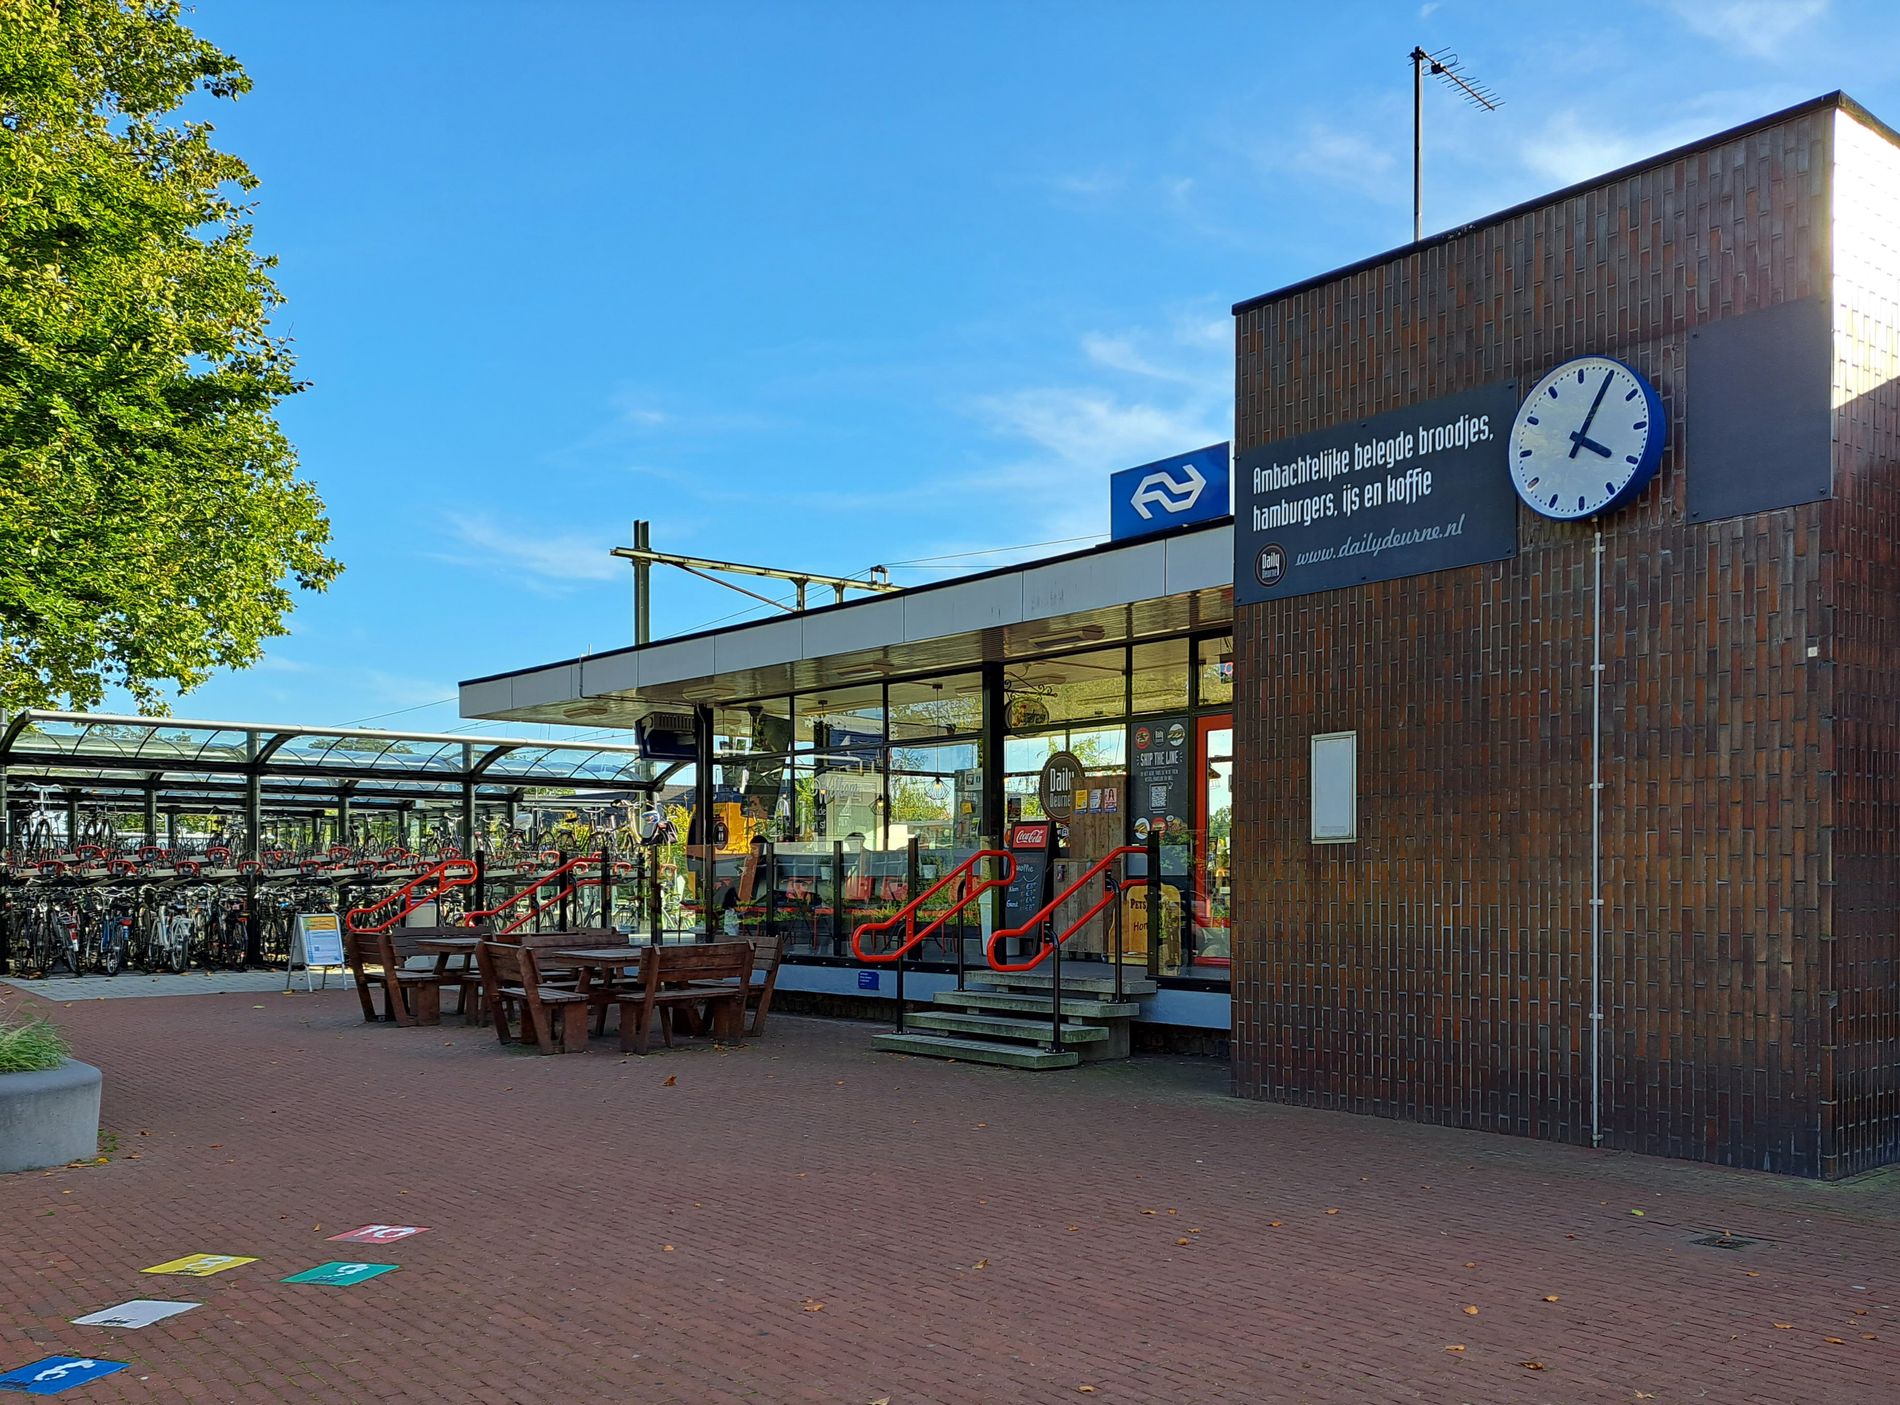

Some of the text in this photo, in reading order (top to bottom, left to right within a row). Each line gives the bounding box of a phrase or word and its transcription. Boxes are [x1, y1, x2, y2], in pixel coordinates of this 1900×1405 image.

[1253, 414, 1494, 494] Ambachtelijke belegde broodjes,
[1253, 467, 1433, 532] hamburgers, ijs en koffie
[1295, 514, 1465, 566] www.dailydeurne.nl
[1261, 551, 1280, 577] Daily
[1153, 751, 1165, 766] THE
[1165, 750, 1179, 765] LINE
[353, 1224, 418, 1239] 10
